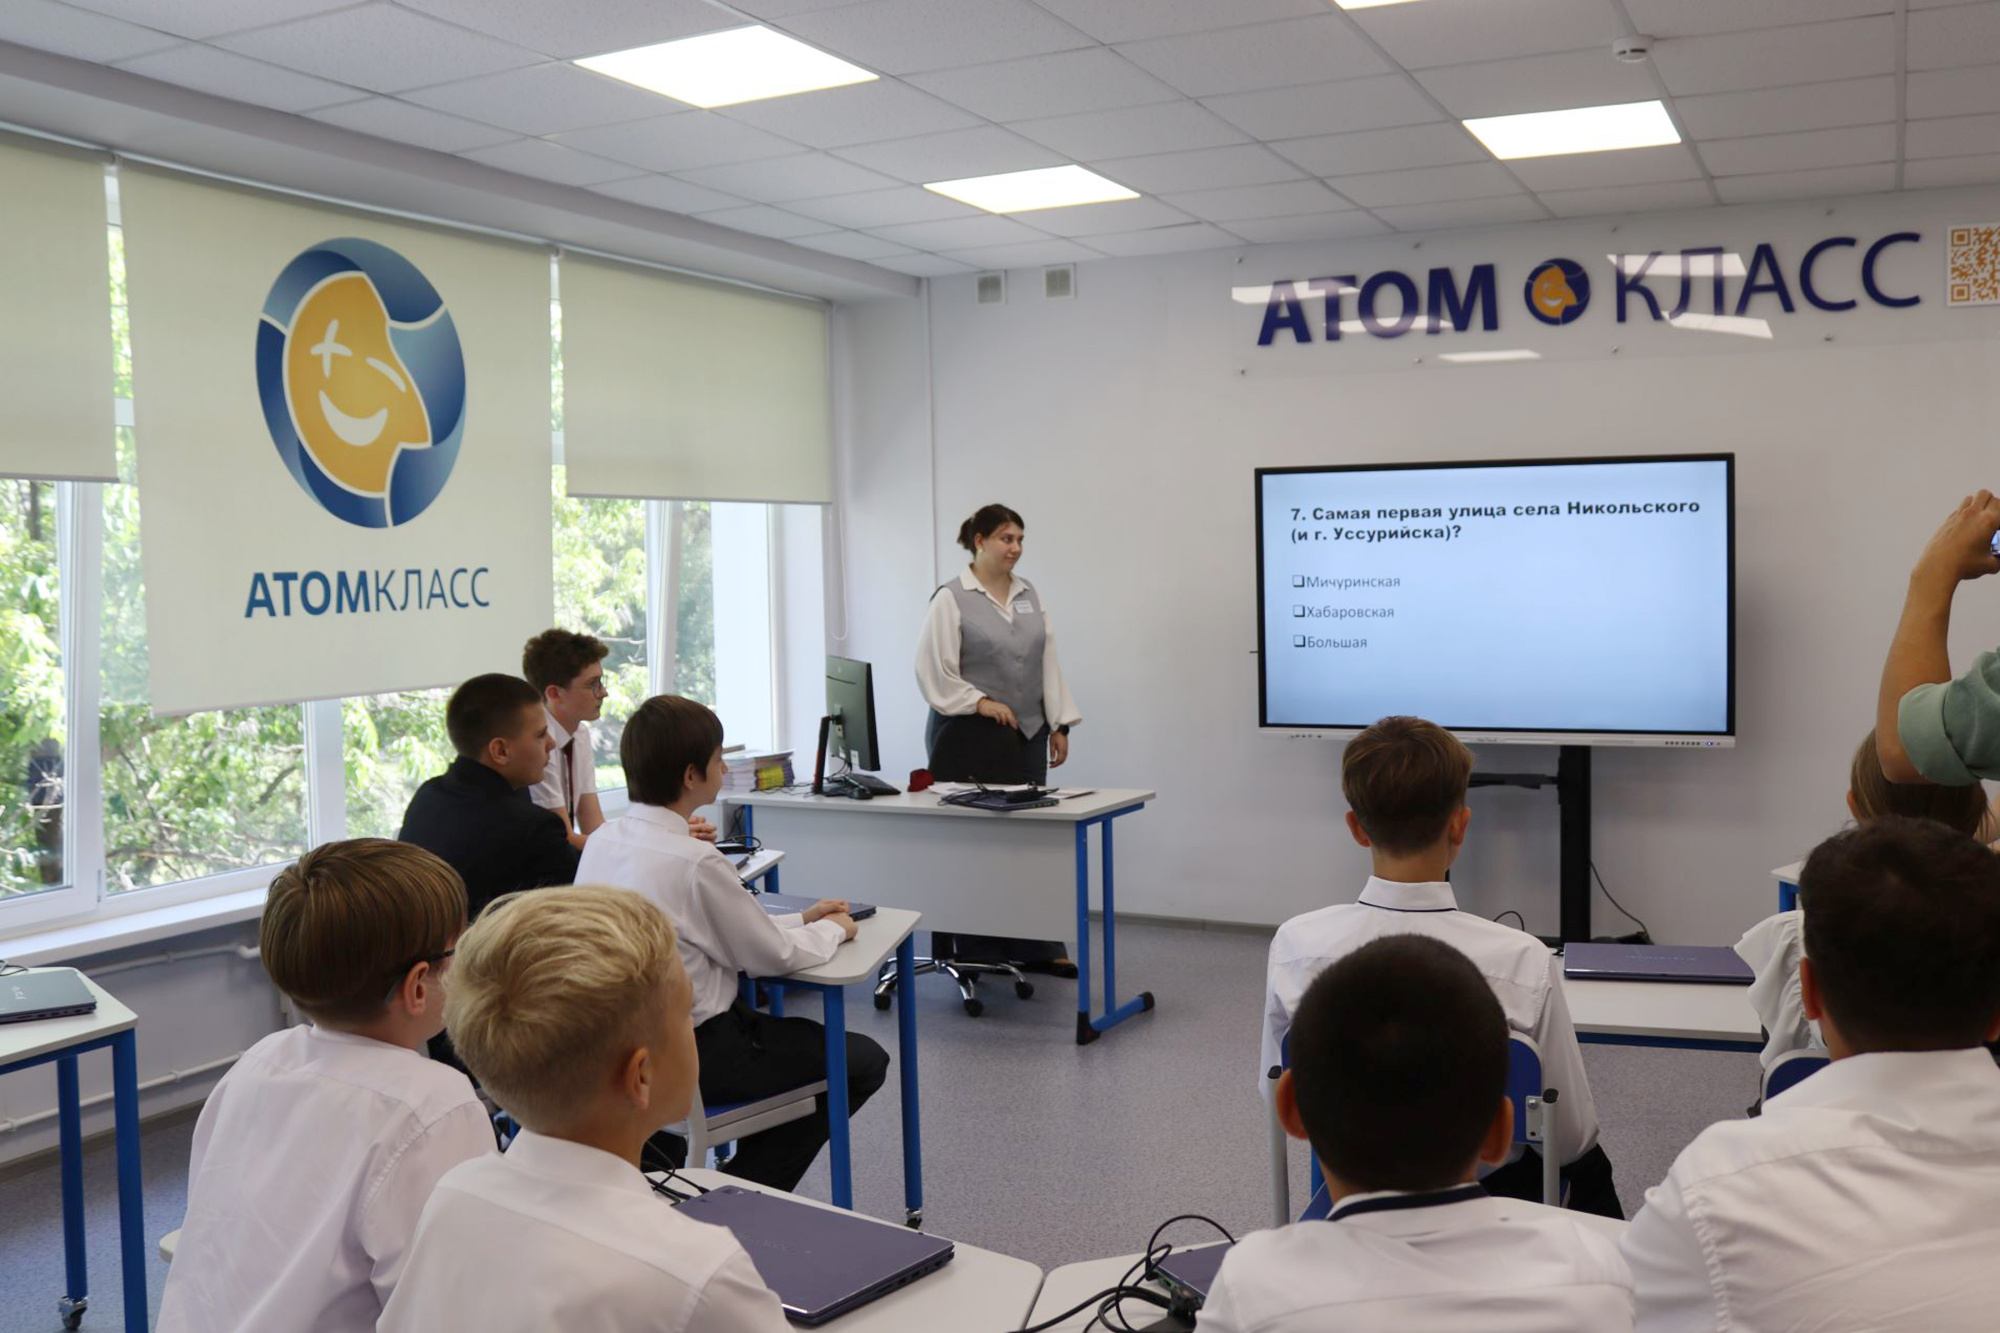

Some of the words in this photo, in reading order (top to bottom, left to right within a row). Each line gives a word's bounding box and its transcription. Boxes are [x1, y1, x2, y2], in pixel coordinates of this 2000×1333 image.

[1257, 262, 1500, 346] АТОМ
[1615, 231, 1922, 324] КЛАСС
[1290, 507, 1306, 520] 7.
[1312, 507, 1371, 520] Самая
[1377, 506, 1442, 522] первая
[1449, 505, 1507, 521] улица
[1513, 504, 1560, 516] села
[1567, 501, 1700, 515] Никольского
[1290, 528, 1308, 544] (и
[1314, 530, 1327, 541] г.
[1333, 525, 1462, 543] Уссурийска)?
[244, 566, 490, 619] АТОМКЛАСС
[1306, 576, 1401, 590] Мичуринская
[1306, 605, 1395, 620] Хабаровская
[1307, 636, 1368, 648] Большая
